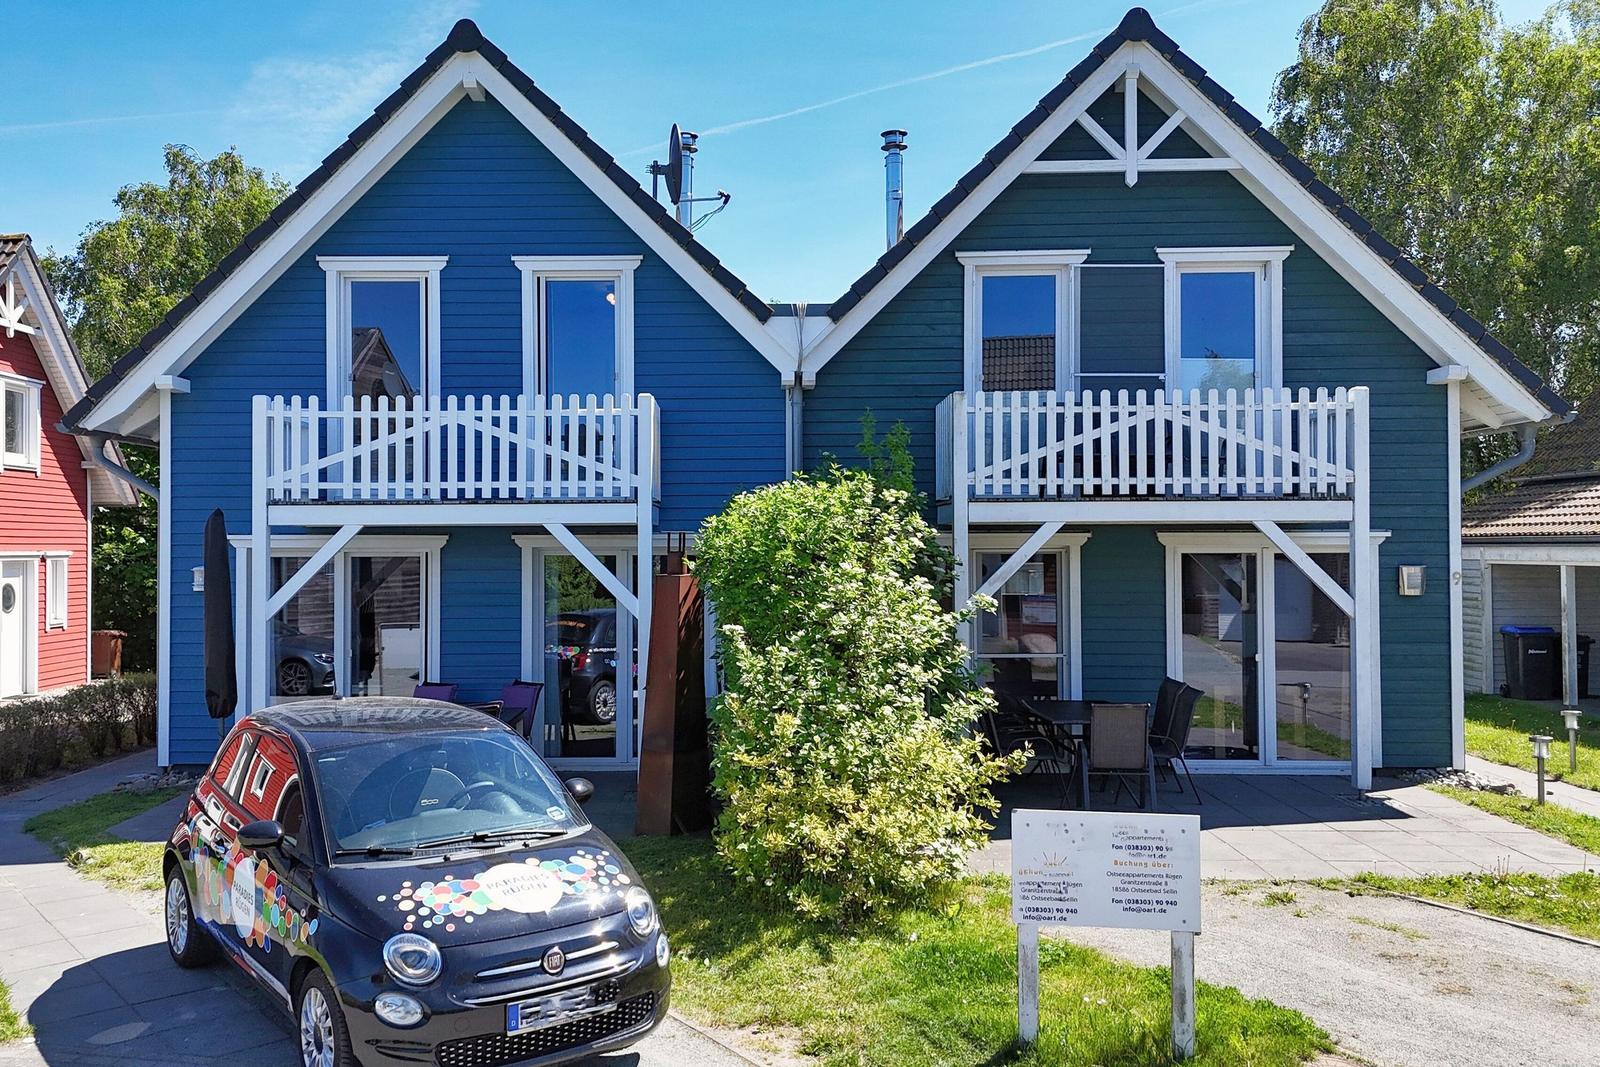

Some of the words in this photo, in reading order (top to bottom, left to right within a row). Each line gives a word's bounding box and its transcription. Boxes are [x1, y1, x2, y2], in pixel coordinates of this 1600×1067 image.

[1452, 571, 1462, 585] 9
[1125, 843, 1154, 852] (038303)
[1113, 860, 1148, 868] Buchung
[1106, 871, 1164, 879] Ostseeappartements
[233, 879, 253, 906] PARADIES
[1125, 898, 1154, 906] (038303)
[1025, 906, 1054, 914] (038303)
[548, 954, 561, 968] FIAT
